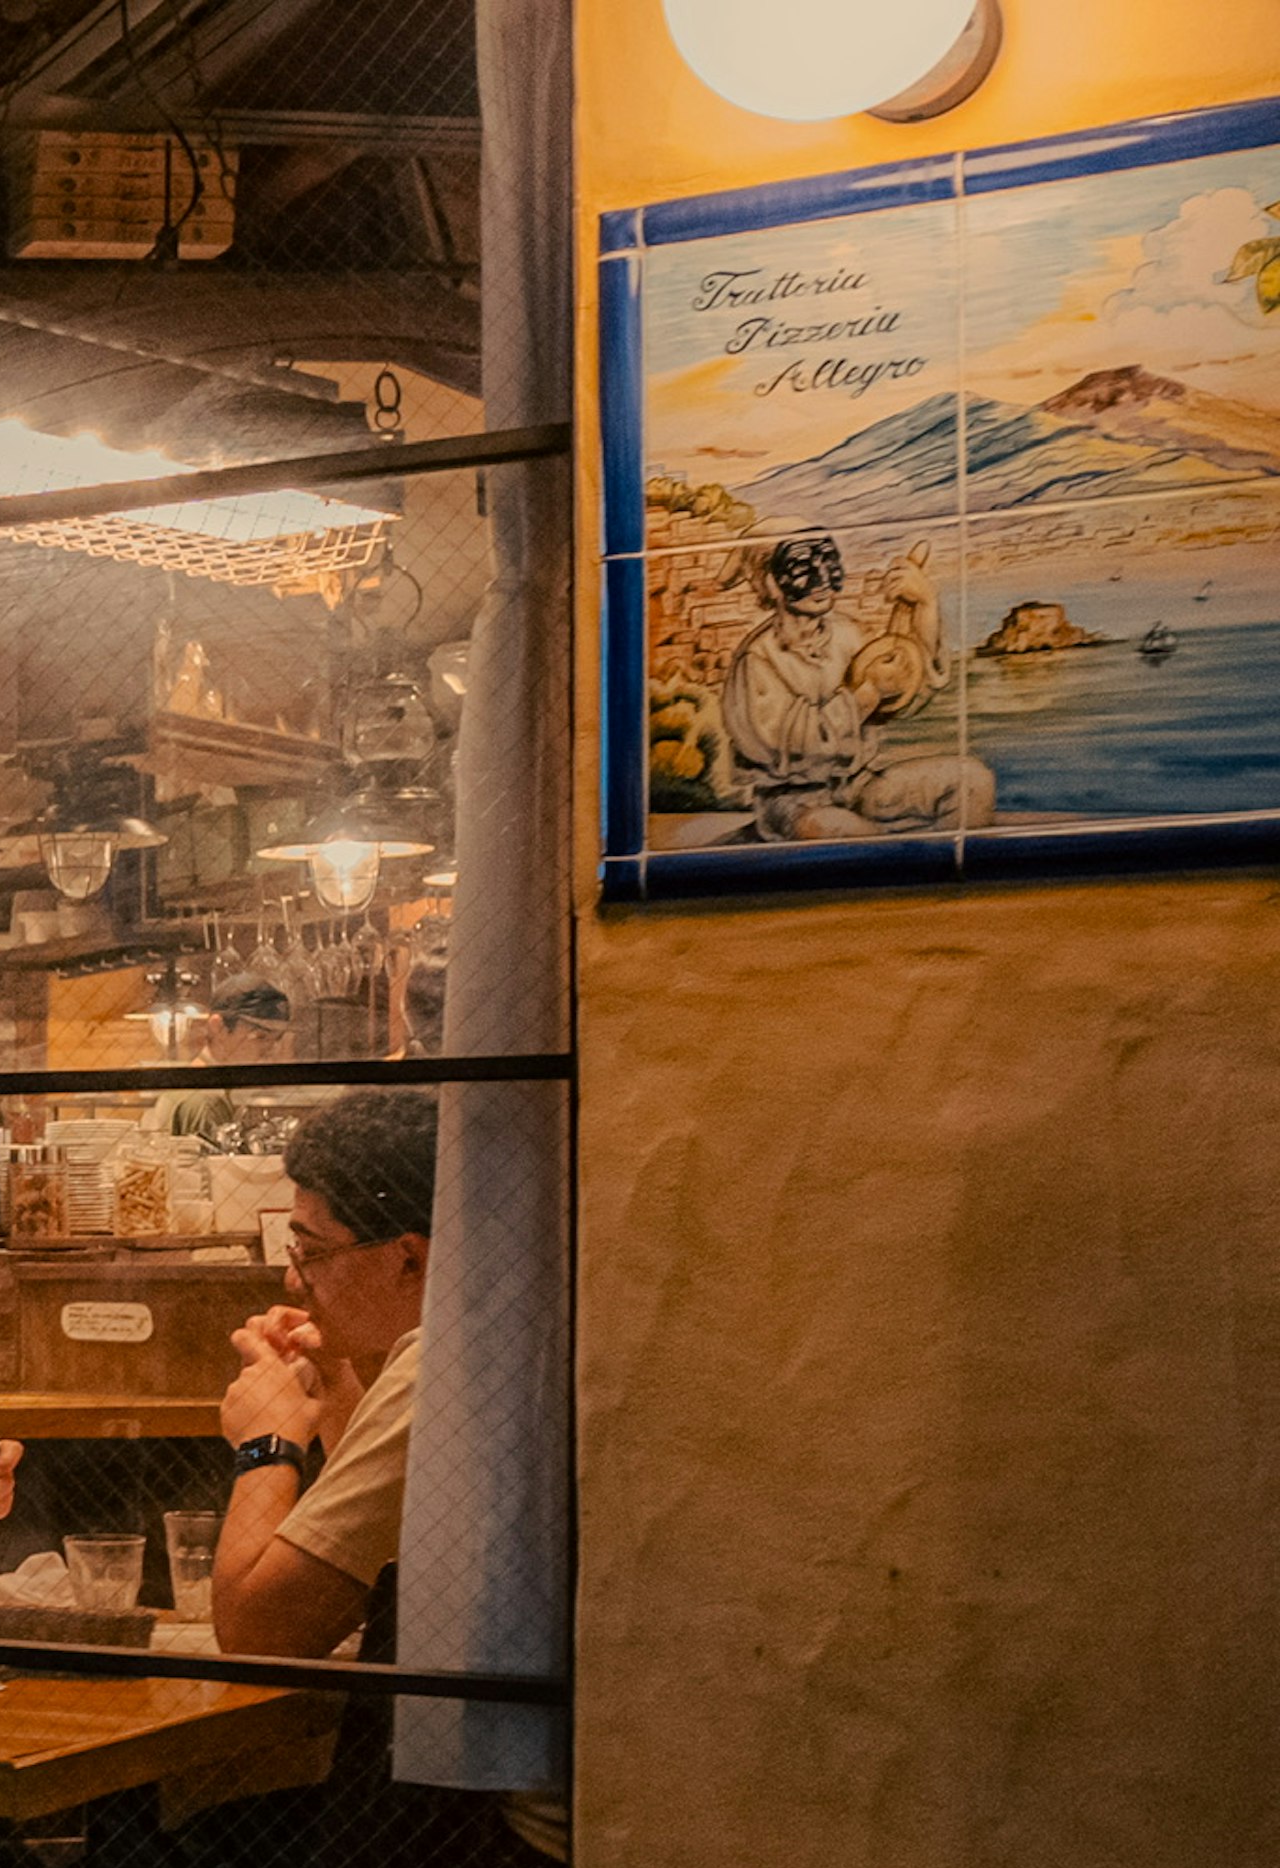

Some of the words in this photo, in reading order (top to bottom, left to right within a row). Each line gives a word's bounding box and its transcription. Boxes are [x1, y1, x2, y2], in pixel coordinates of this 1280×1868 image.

[693, 267, 869, 312] Trattoria
[724, 306, 902, 354] Pizzeria
[754, 356, 930, 399] Allegro
